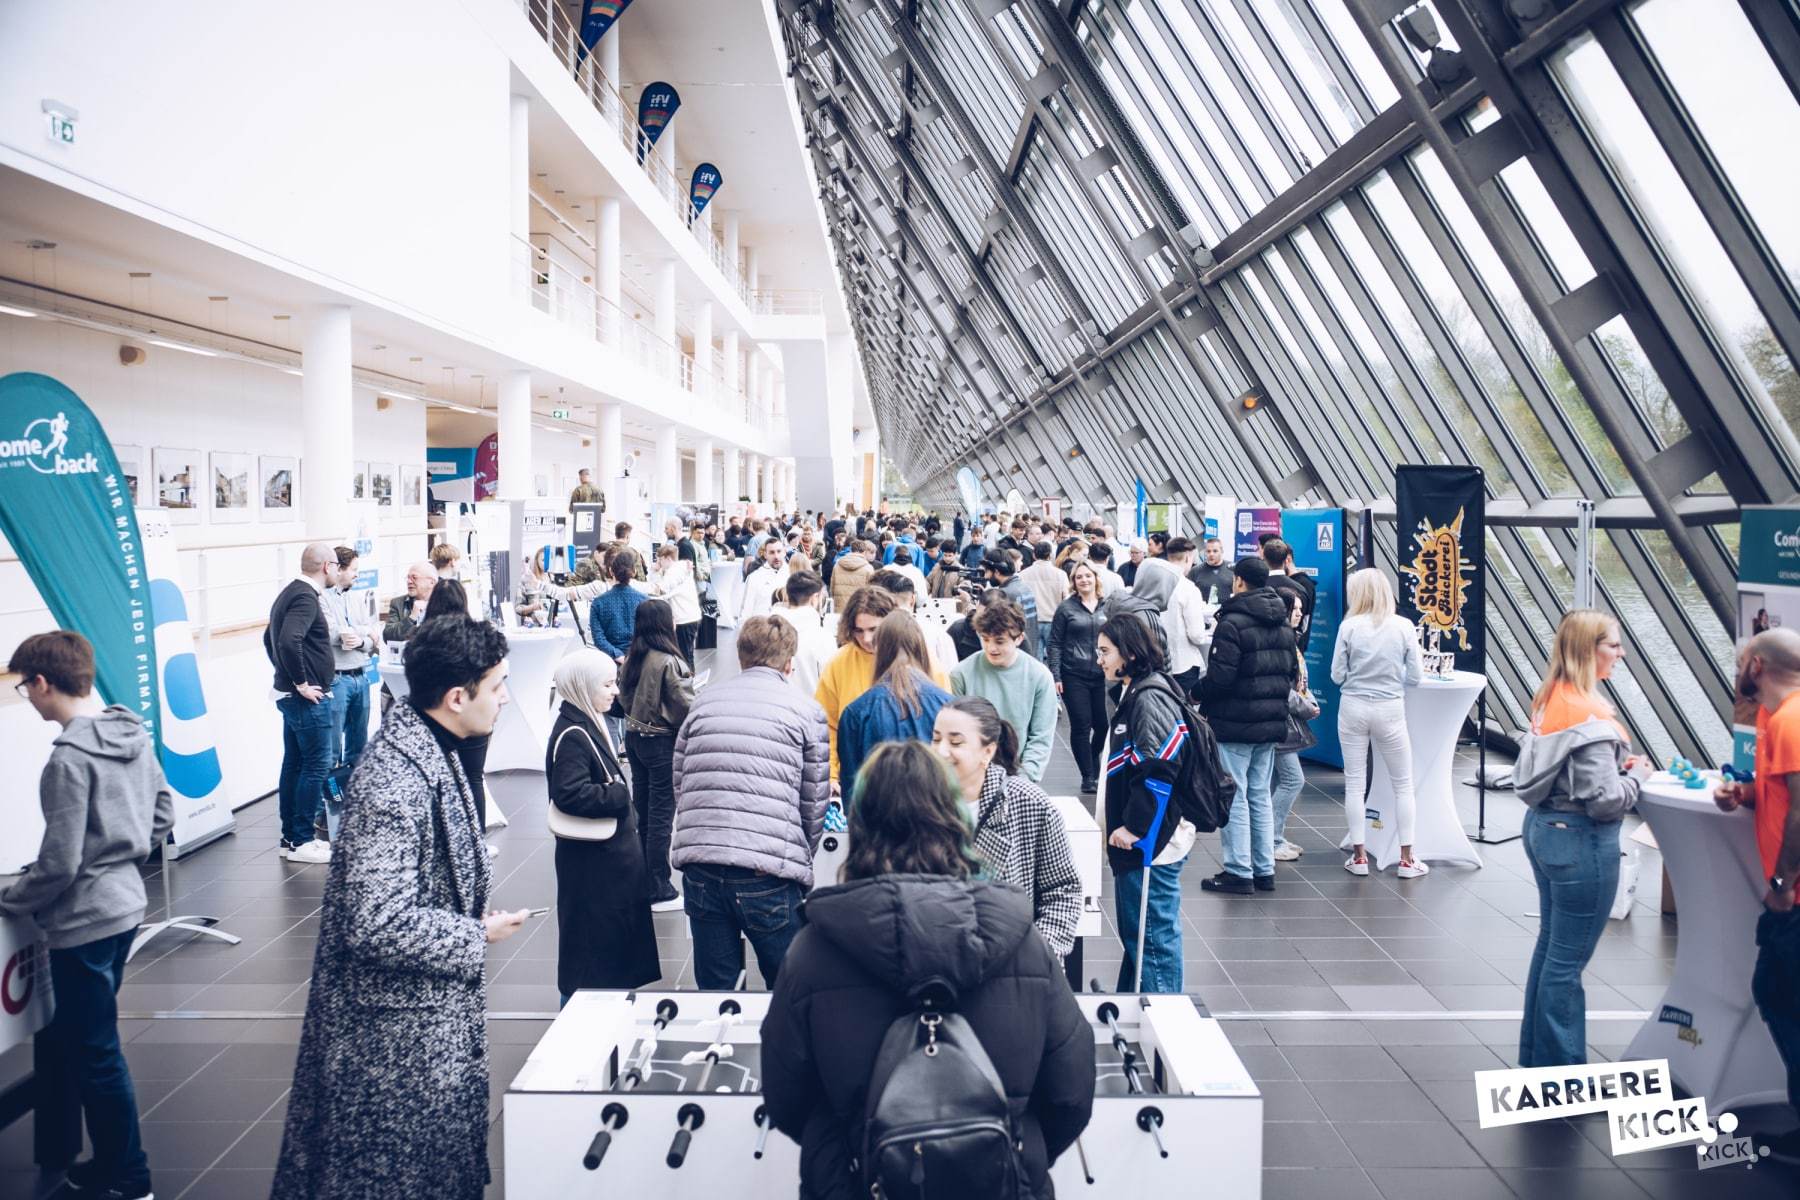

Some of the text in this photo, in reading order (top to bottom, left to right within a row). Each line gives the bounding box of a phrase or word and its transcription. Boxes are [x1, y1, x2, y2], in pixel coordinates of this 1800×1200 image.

[0, 438, 42, 457] ome
[55, 452, 99, 474] back
[104, 473, 124, 509] WIR
[115, 515, 140, 589] MACHEN
[1774, 530, 1800, 547] Com
[1419, 549, 1439, 607] Stadt
[1438, 541, 1453, 617] Bäckerei
[130, 599, 146, 645] JEDE
[136, 653, 152, 711] FIRMA
